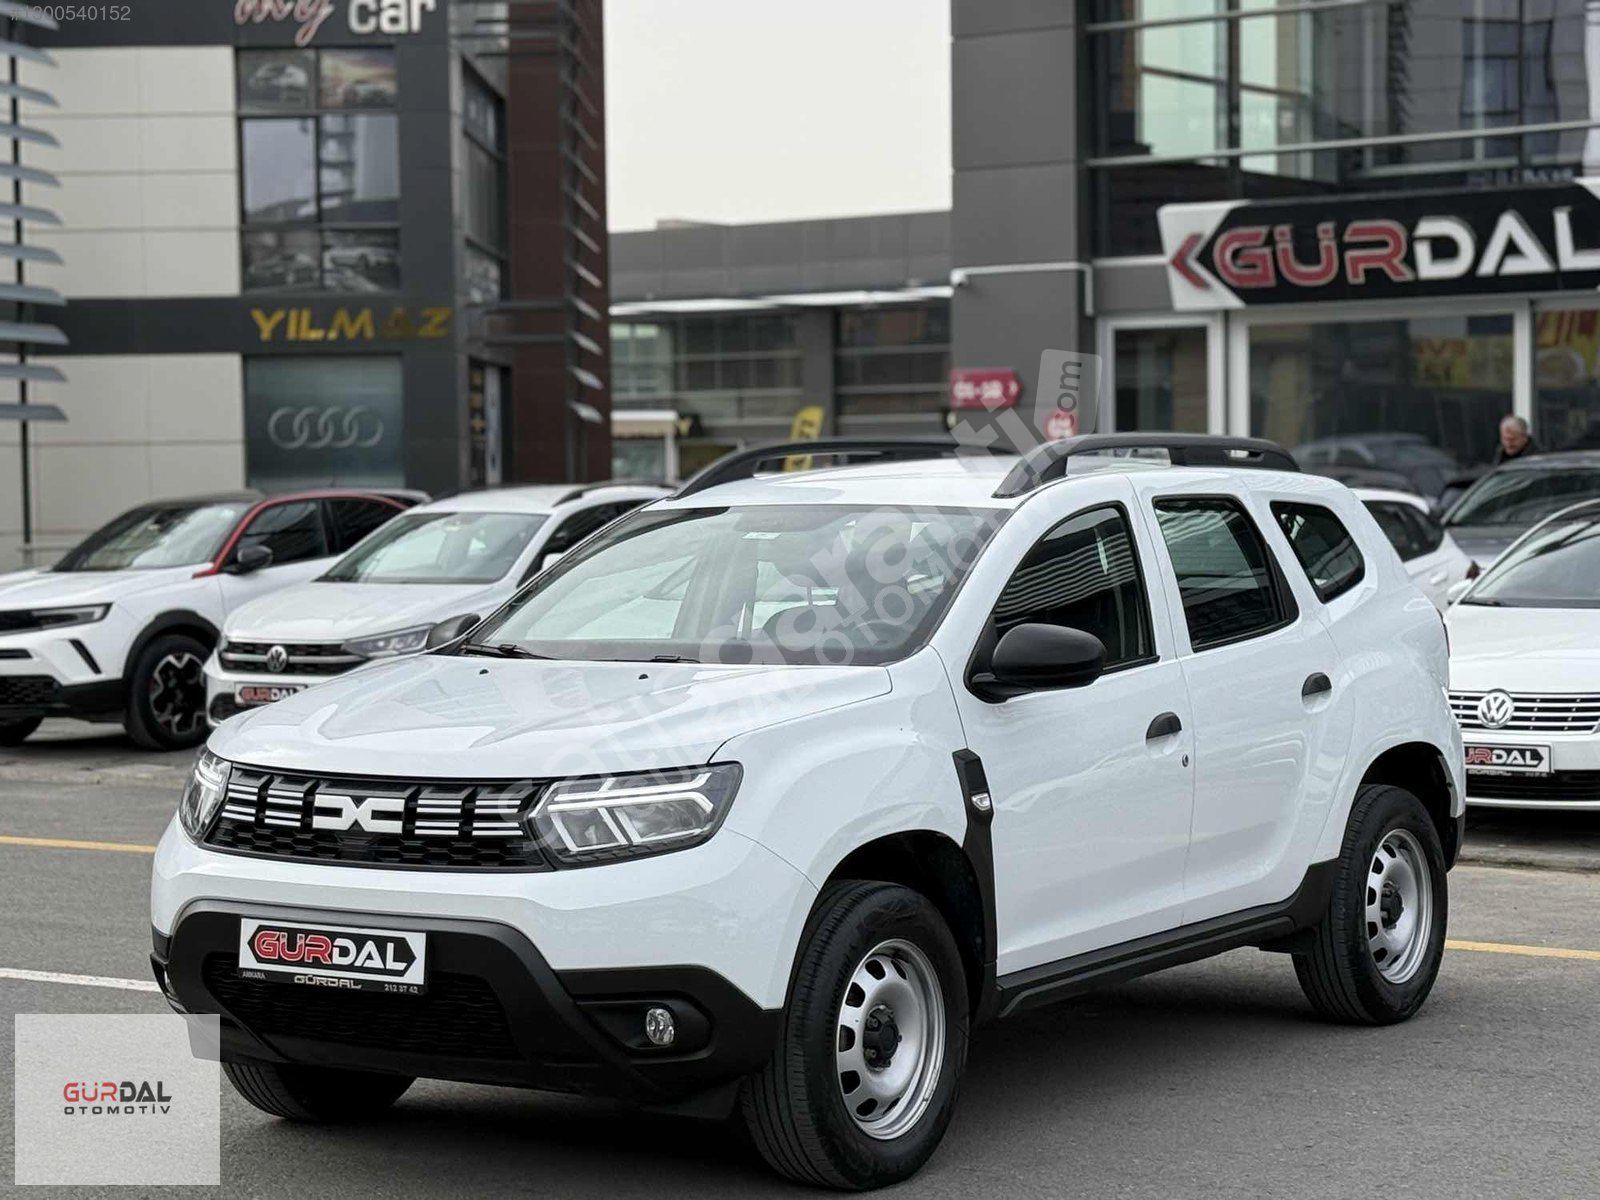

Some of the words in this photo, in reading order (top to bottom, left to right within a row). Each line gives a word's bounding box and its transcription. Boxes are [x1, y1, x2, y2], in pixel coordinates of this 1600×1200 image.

[348, 0, 436, 34] car
[1213, 205, 1600, 288] GÜRDAL
[250, 306, 451, 342] YILMAZ
